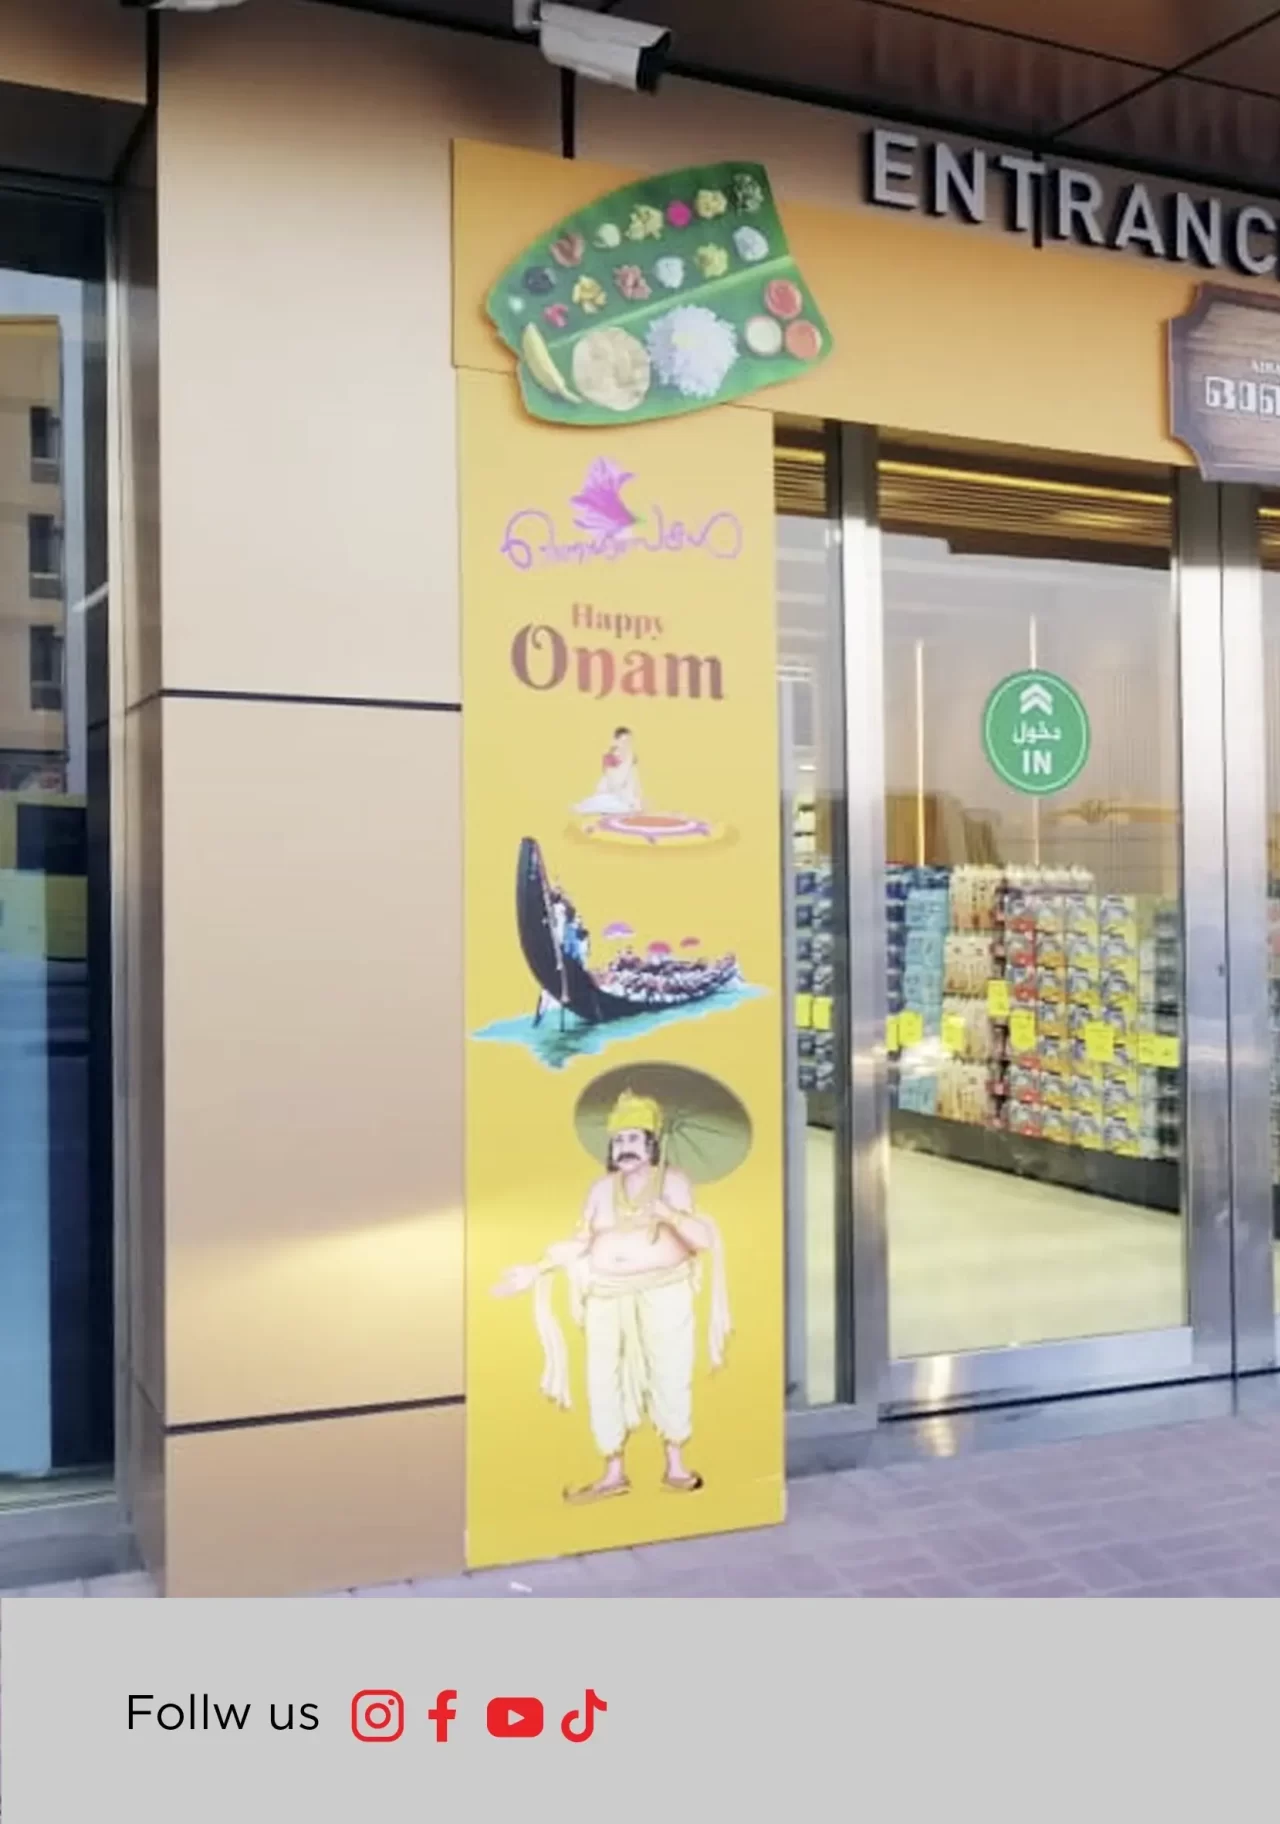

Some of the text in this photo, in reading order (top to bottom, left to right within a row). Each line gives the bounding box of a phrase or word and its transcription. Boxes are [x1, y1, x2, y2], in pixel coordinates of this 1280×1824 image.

[571, 601, 665, 640] Happy
[510, 622, 725, 701] Onam
[1012, 720, 1062, 745] دخول
[1022, 748, 1053, 776] IN
